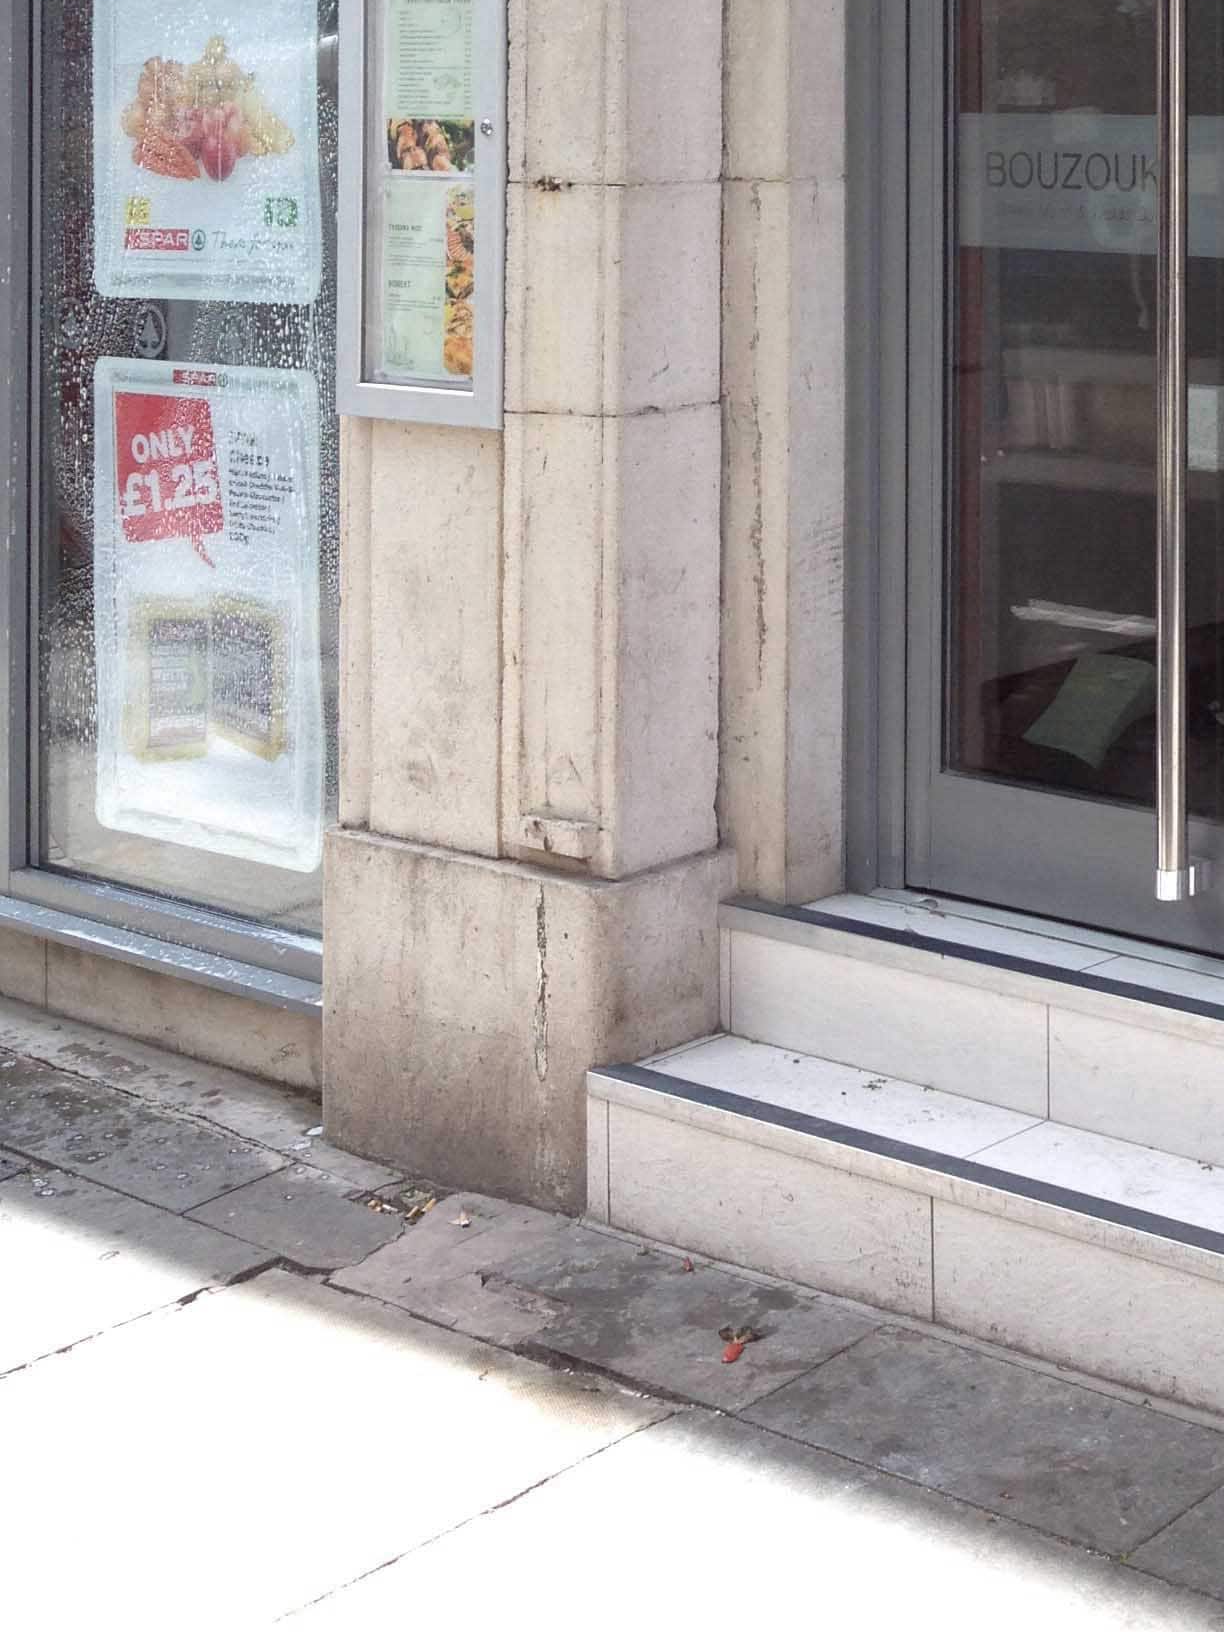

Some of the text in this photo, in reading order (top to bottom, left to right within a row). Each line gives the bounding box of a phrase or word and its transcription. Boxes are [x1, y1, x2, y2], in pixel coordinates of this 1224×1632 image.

[986, 151, 1158, 191] BOUZOUK
[139, 232, 188, 248] SPAR
[131, 425, 195, 464] ONLY
[123, 462, 217, 517] £1.25
